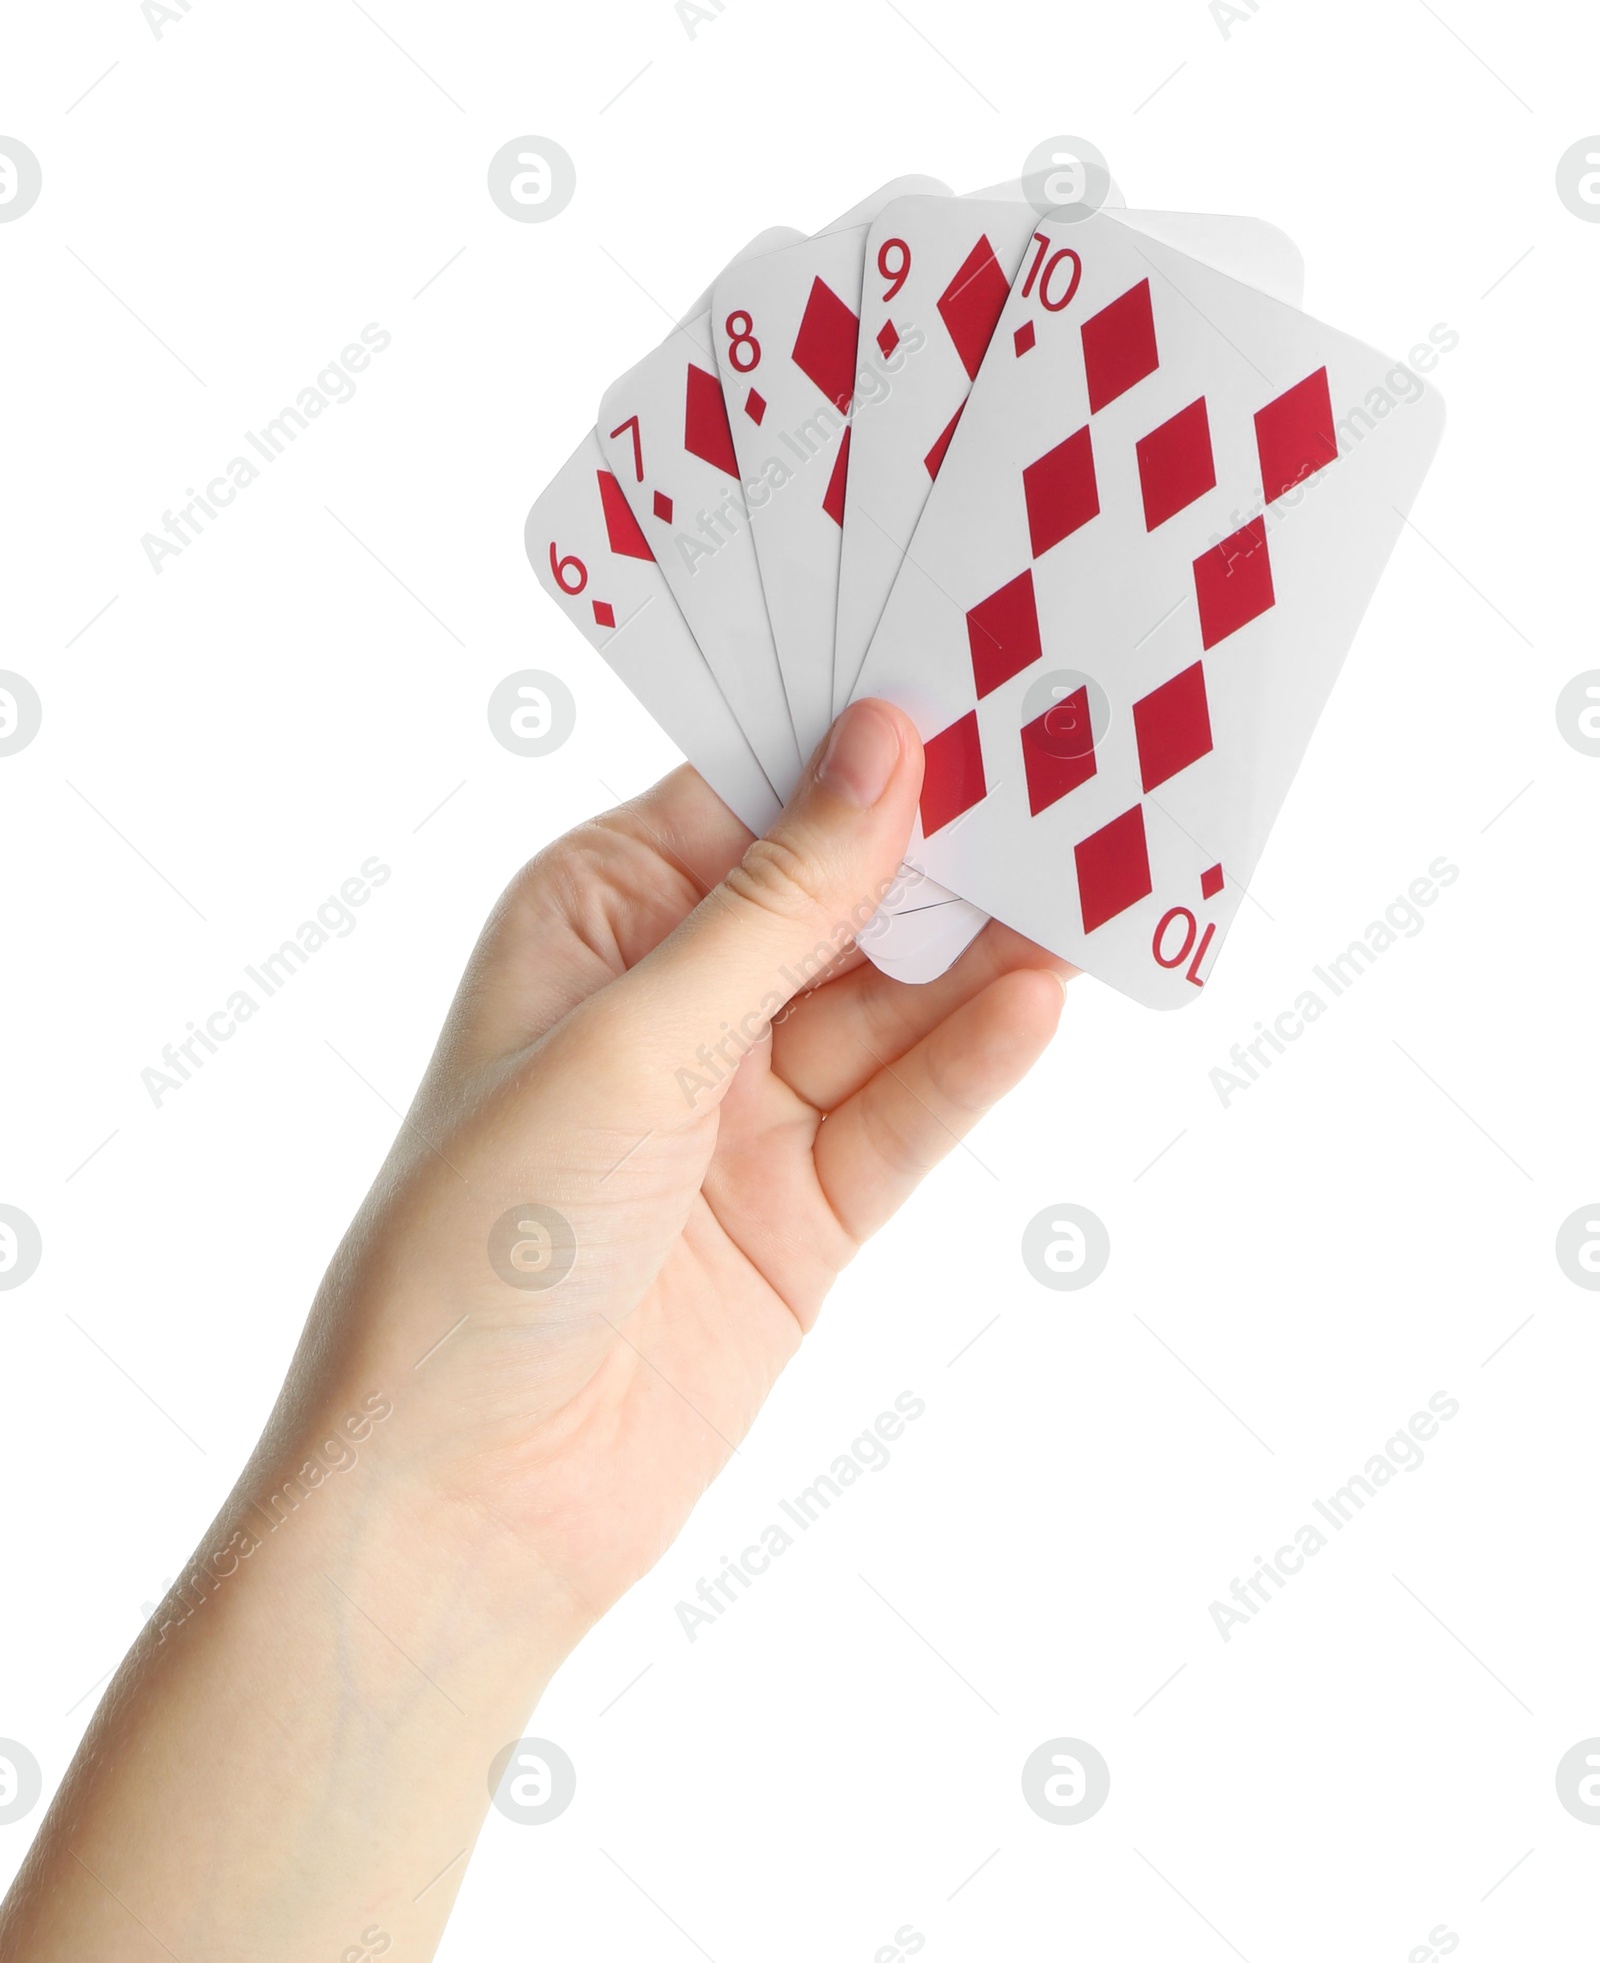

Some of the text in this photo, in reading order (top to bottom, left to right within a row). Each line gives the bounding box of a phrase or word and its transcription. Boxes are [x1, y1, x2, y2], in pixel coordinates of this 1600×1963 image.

[876, 237, 911, 302] 9
[1021, 232, 1082, 312] 10
[725, 309, 762, 373] 8
[610, 415, 644, 482] 7
[549, 541, 588, 596] 6
[1151, 906, 1216, 987] 10
